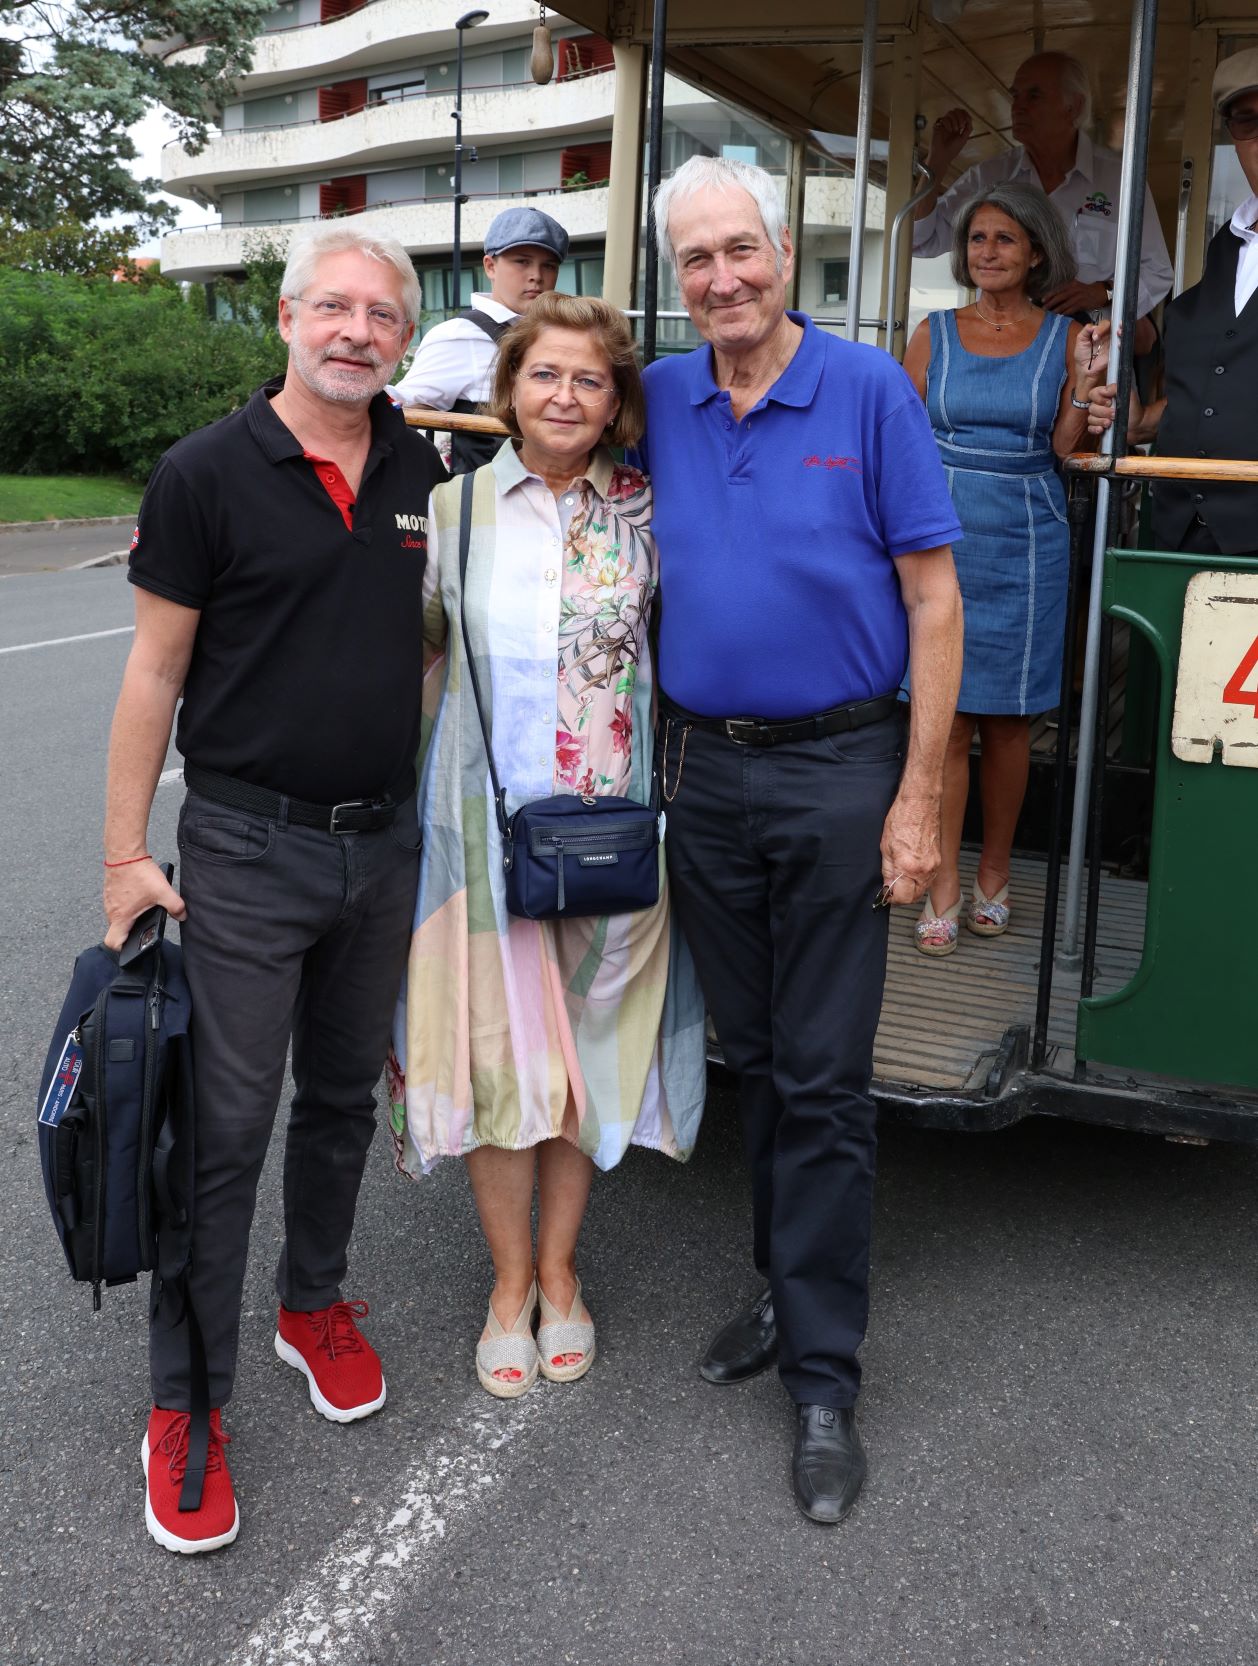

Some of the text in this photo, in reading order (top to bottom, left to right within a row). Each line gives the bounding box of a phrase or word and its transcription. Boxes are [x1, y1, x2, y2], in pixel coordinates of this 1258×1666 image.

[1222, 634, 1258, 719] 4
[61, 1056, 71, 1071] AUTO
[72, 1059, 82, 1074] TOUR
